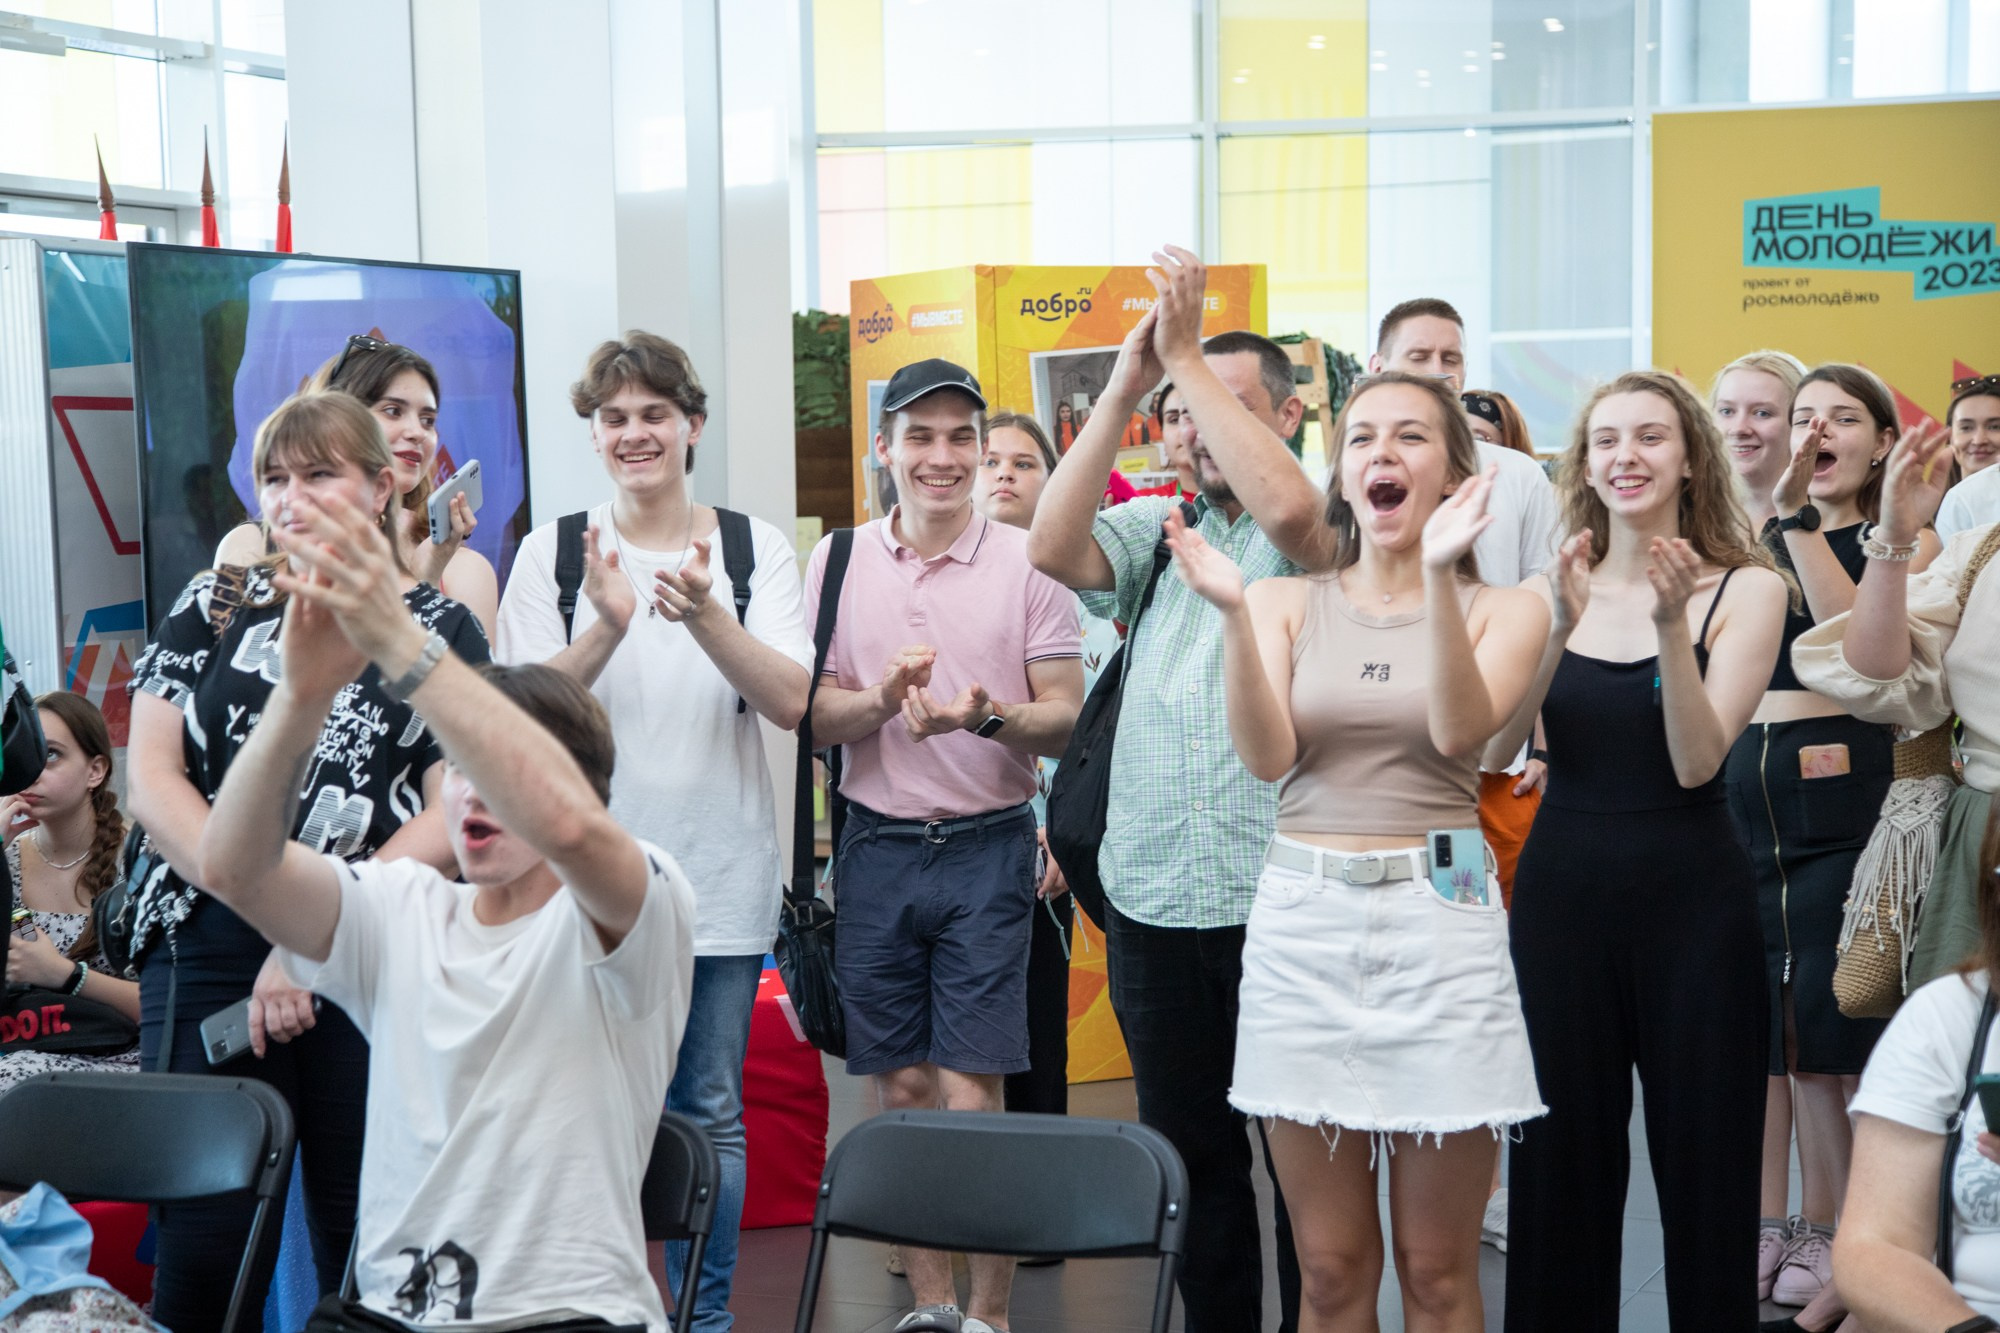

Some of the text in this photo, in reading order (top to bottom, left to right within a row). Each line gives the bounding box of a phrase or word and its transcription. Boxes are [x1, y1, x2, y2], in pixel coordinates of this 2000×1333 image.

[1752, 203, 1874, 236] ДЕНЬ
[1752, 226, 1992, 264] МОЛОДЁЖИ
[1743, 276, 1811, 290] проект от
[1922, 257, 2000, 292] 2023
[1020, 292, 1092, 318] добро
[1743, 289, 1880, 312] росмолодёжь
[858, 310, 893, 338] добро
